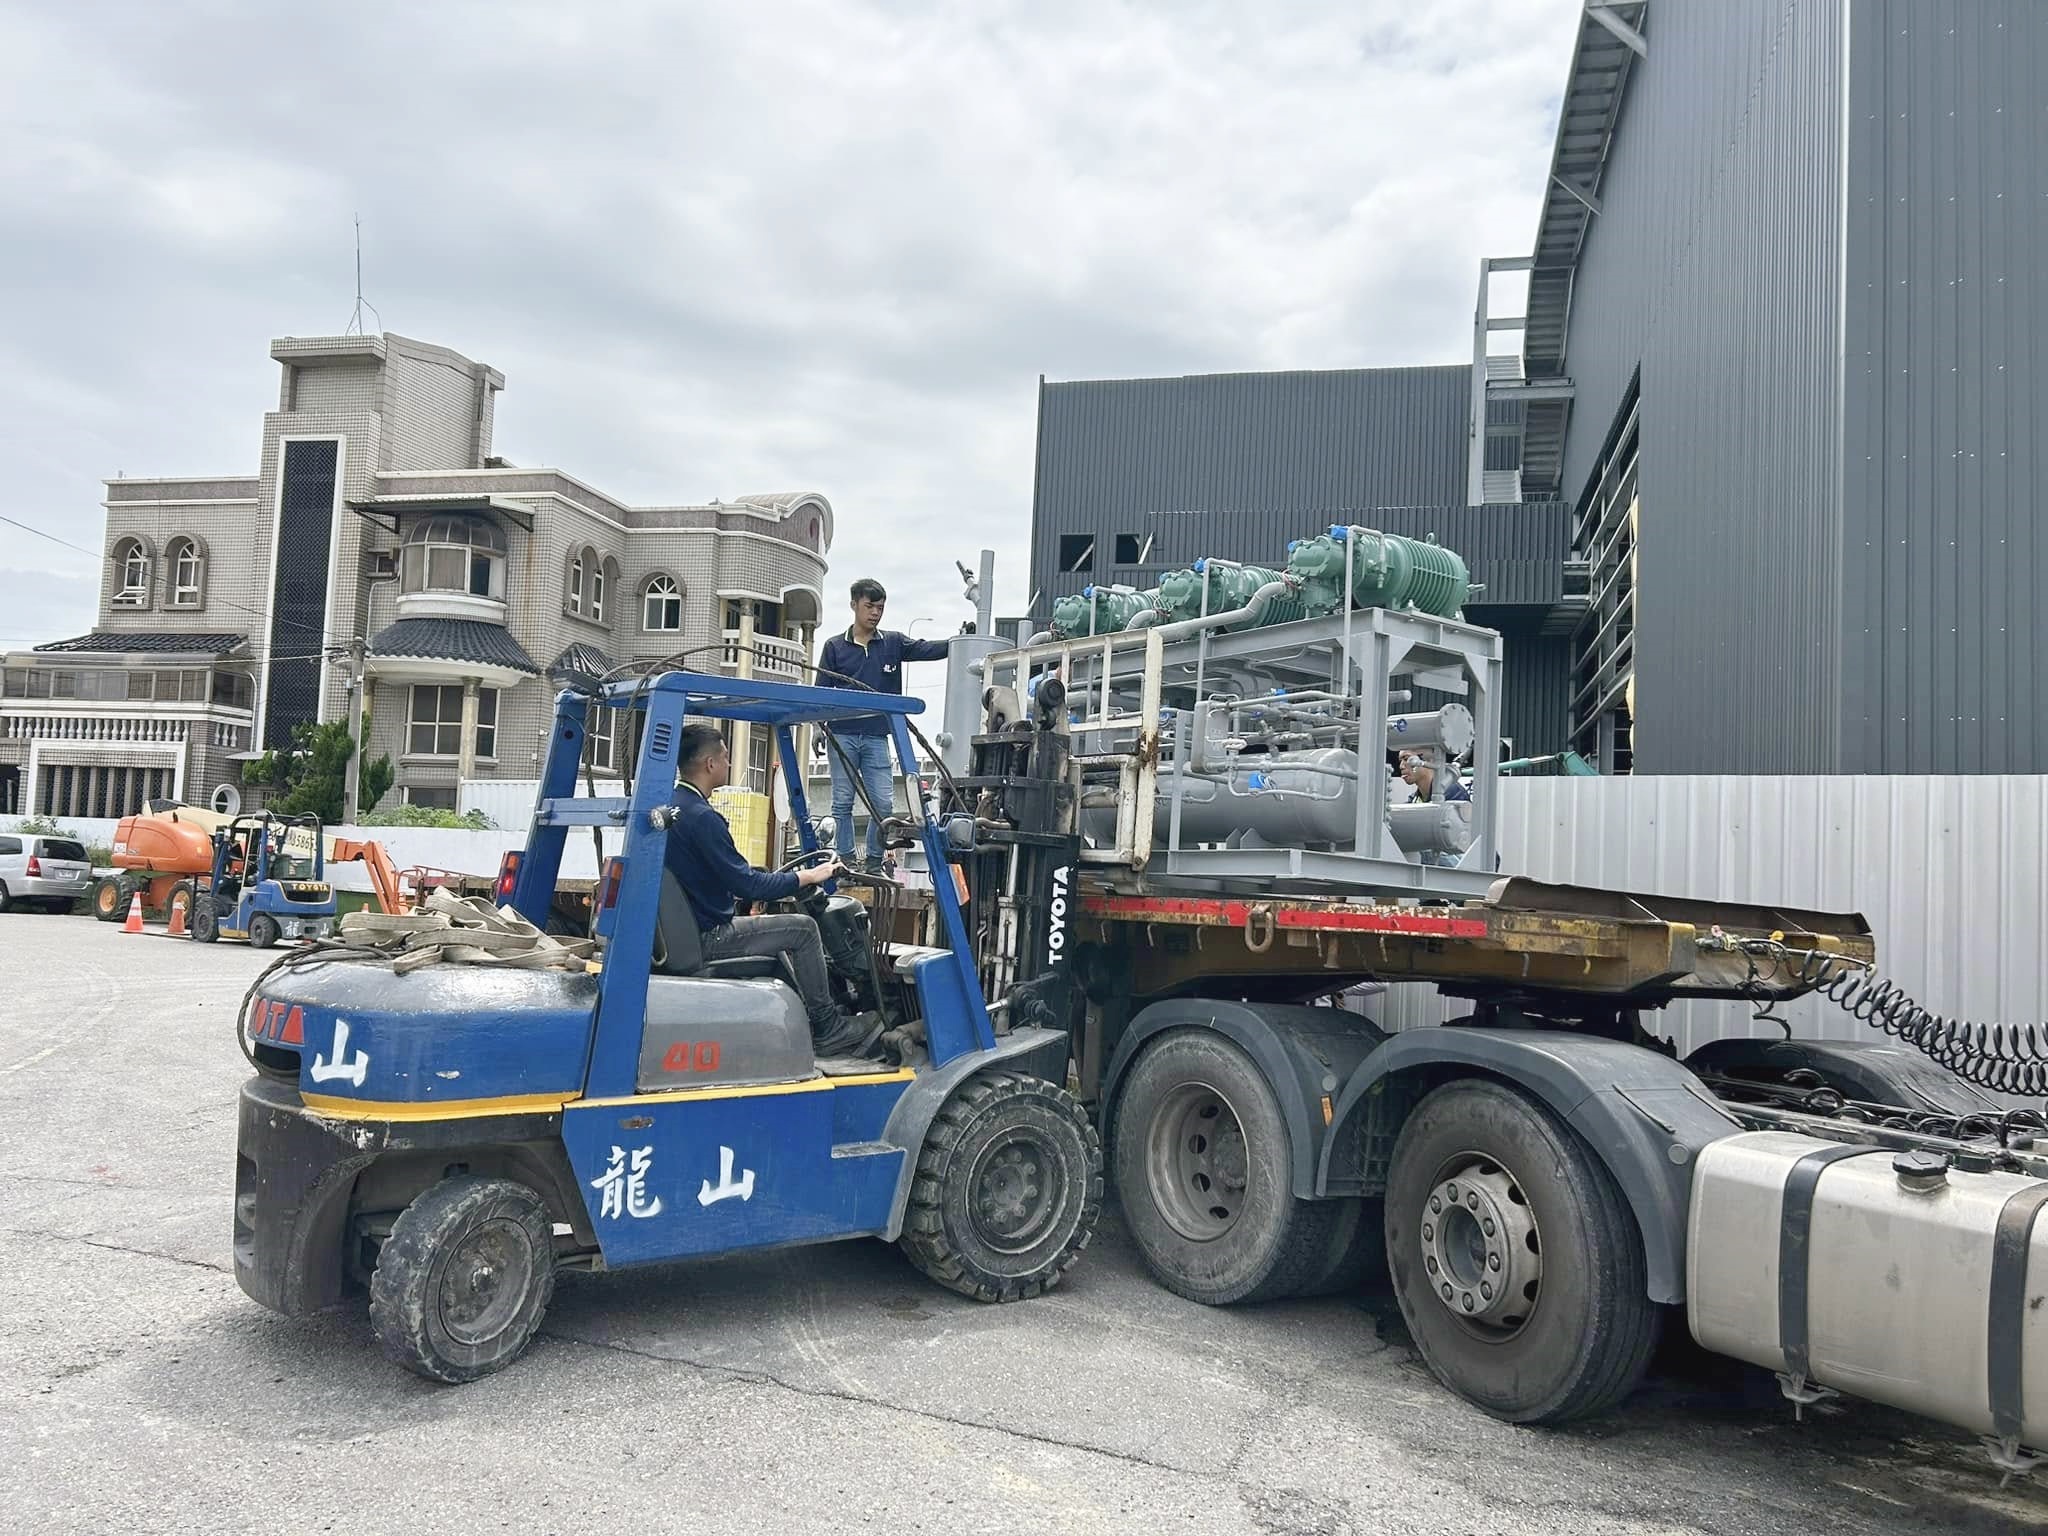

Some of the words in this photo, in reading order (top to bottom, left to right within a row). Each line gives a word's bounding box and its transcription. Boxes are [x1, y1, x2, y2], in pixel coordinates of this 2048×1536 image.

[291, 883, 329, 892] TOYOTA
[1047, 865, 1070, 966] TOYOTA
[310, 1018, 369, 1088] 山
[661, 1040, 721, 1072] 40
